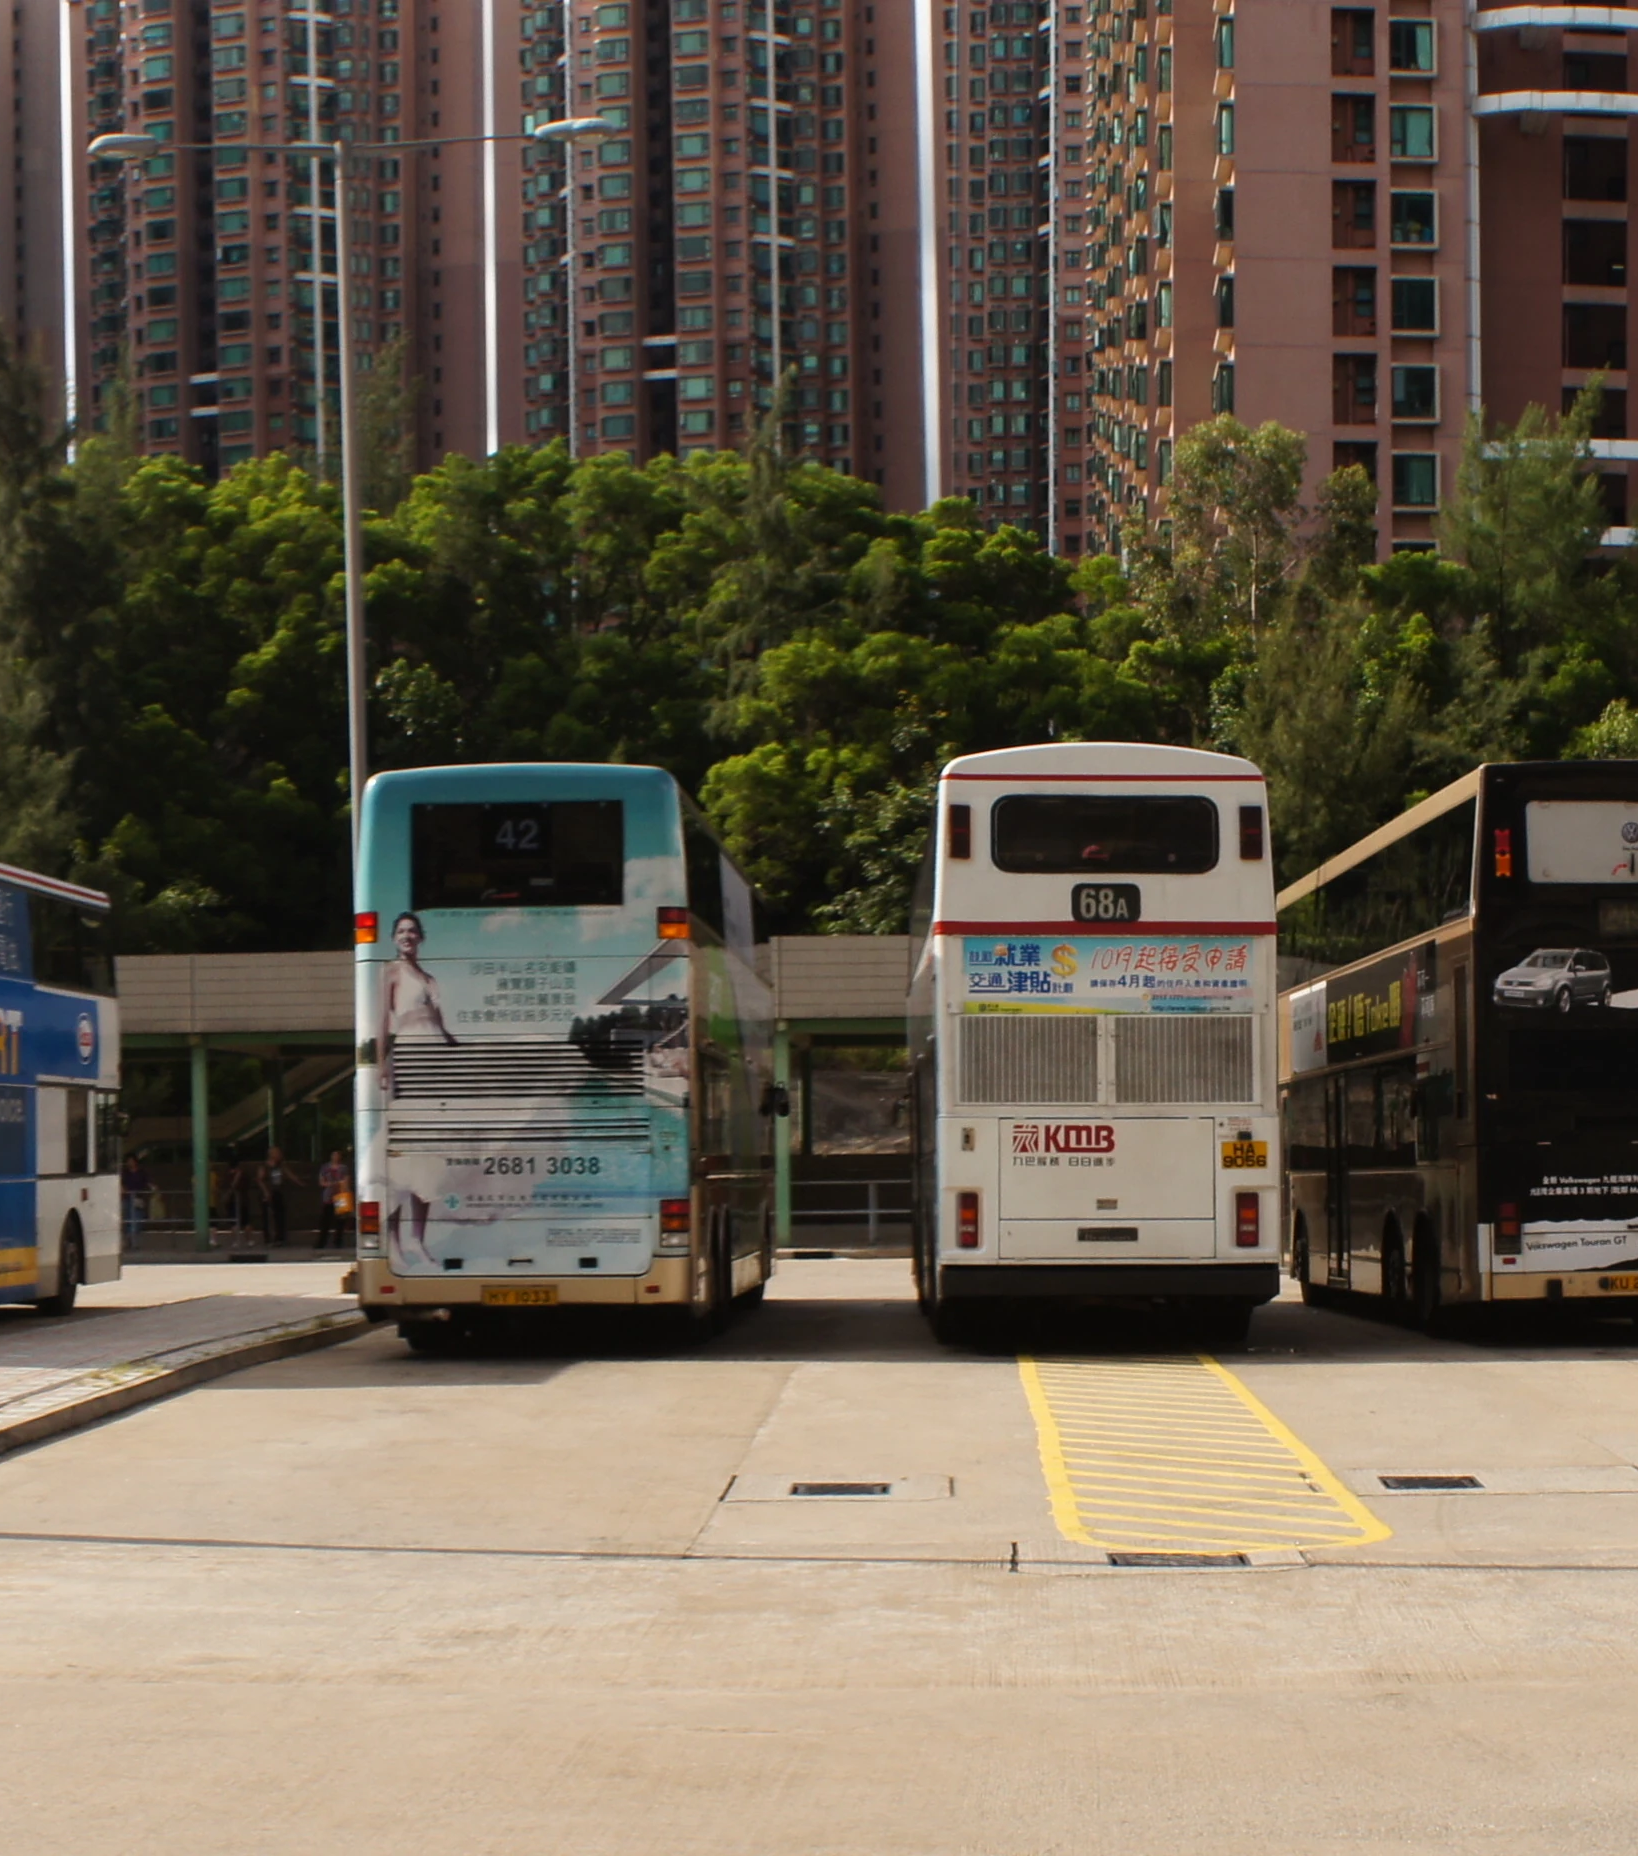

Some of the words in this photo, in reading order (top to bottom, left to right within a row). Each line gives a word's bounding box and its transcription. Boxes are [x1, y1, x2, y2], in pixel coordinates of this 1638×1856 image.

[495, 819, 539, 849] 42
[1080, 888, 1129, 919] 68A
[1044, 1124, 1116, 1154] KMB
[1233, 1143, 1256, 1156] HA
[483, 1156, 536, 1176] 2681
[546, 1156, 601, 1175] 3038
[1222, 1155, 1267, 1168] 9056
[1580, 1237, 1612, 1247] Touran
[1614, 1235, 1628, 1245] GT
